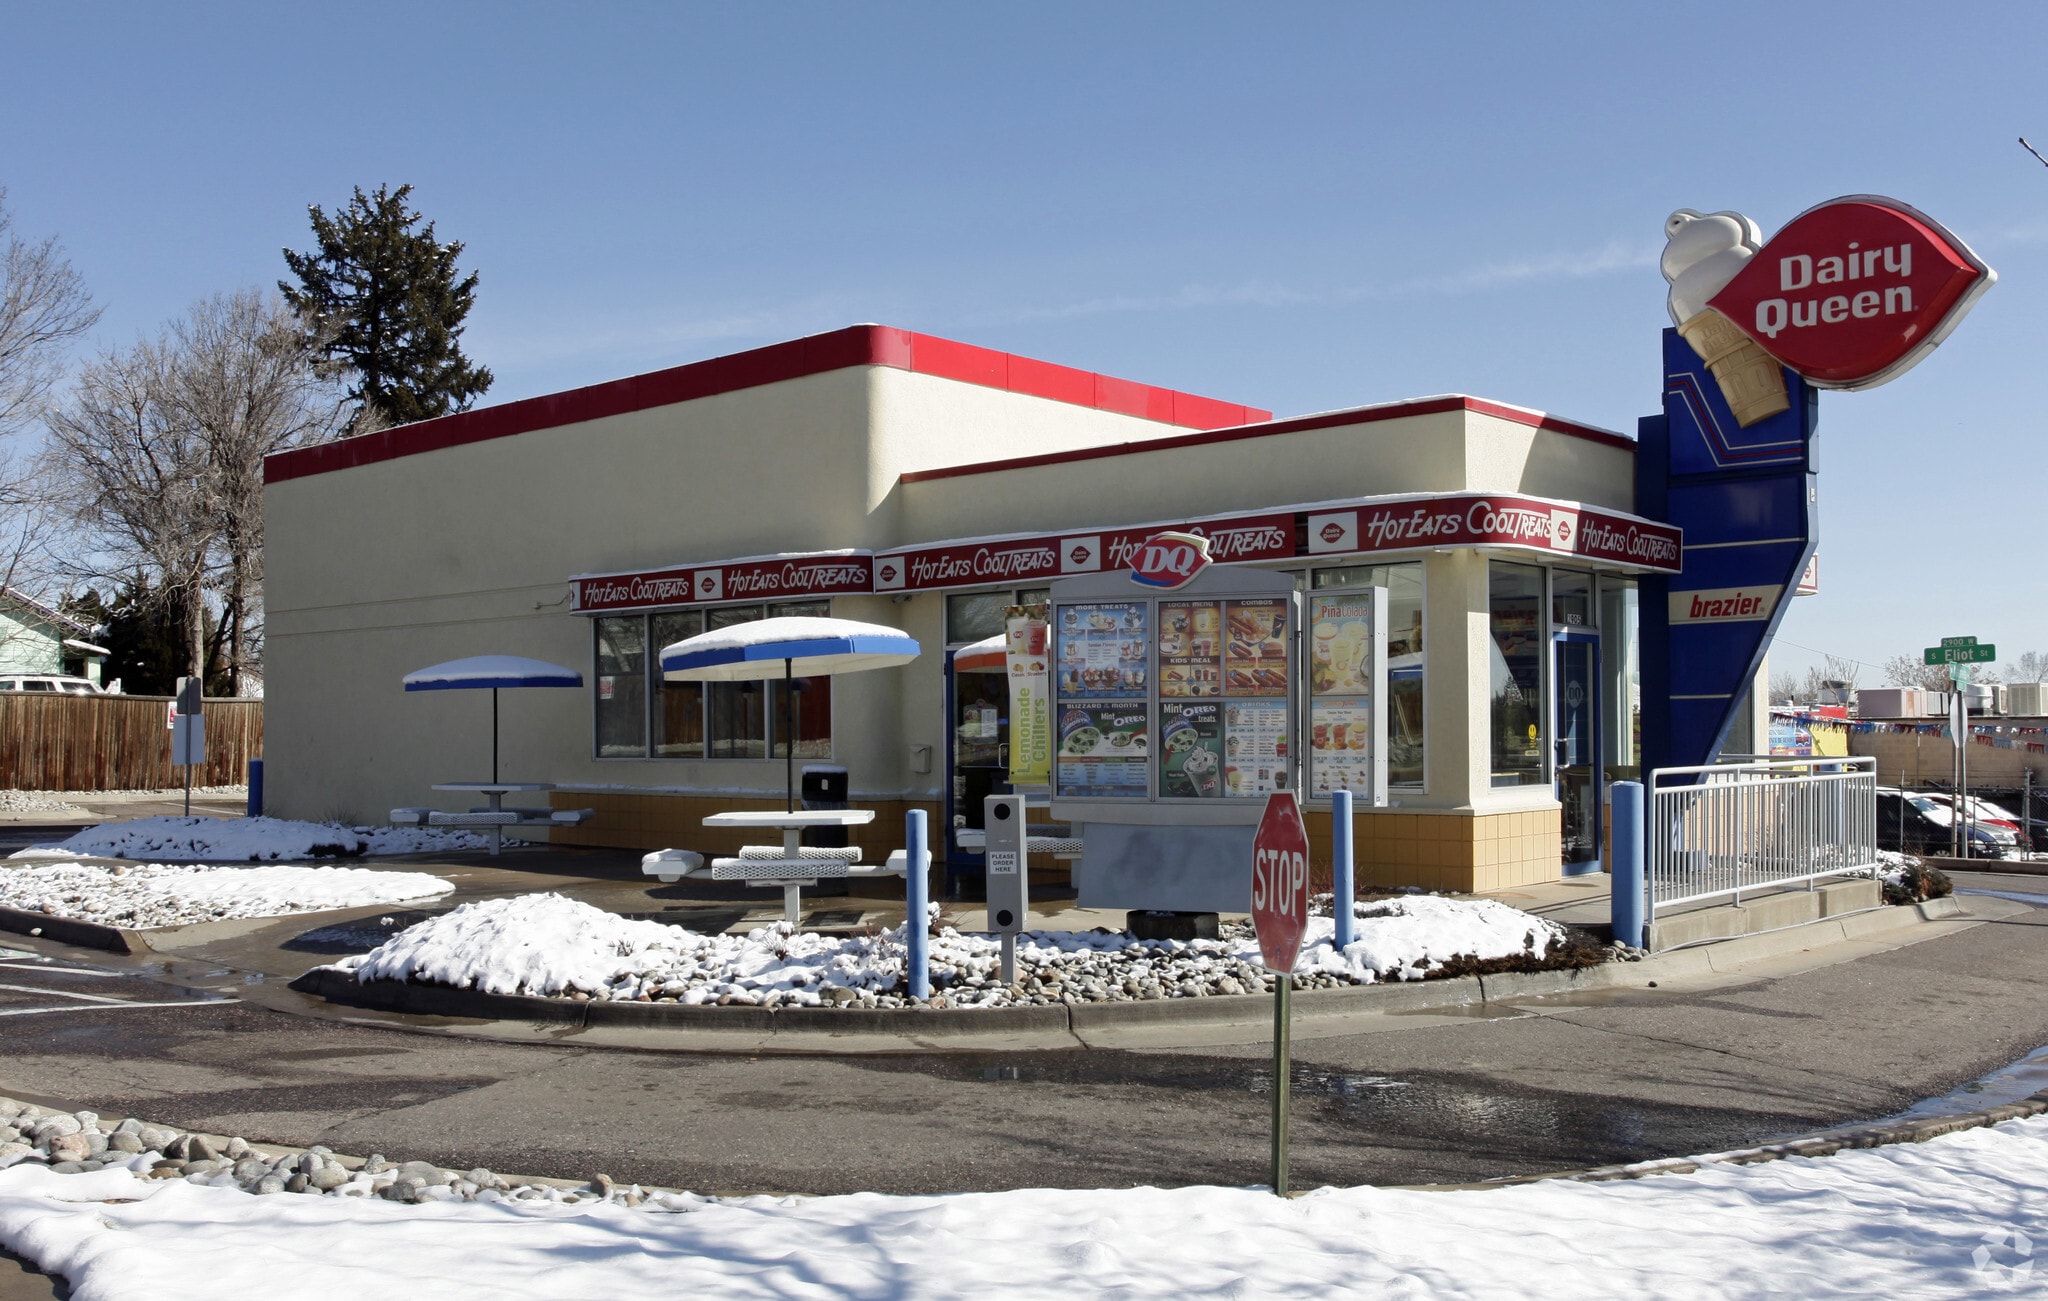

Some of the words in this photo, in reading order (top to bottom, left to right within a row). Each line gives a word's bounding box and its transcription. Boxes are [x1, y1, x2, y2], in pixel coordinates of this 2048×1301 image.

[1780, 242, 1912, 292] Dairy
[1756, 285, 1913, 339] Queen
[1141, 545, 1196, 576] DQ
[1321, 604, 1341, 618] Piña
[1341, 604, 1368, 618] Colada
[1689, 592, 1763, 618] brazier
[1931, 652, 1937, 660] S
[1944, 648, 1974, 662] Eliot
[1943, 638, 1964, 647] 2900
[1101, 712, 1115, 720] Mint
[1113, 715, 1146, 727] OREO
[1163, 703, 1183, 714] Mint
[1183, 705, 1216, 717] OREO
[1017, 687, 1031, 773] Lemonade
[1032, 698, 1046, 762] Chillers
[1254, 847, 1304, 917] STOP
